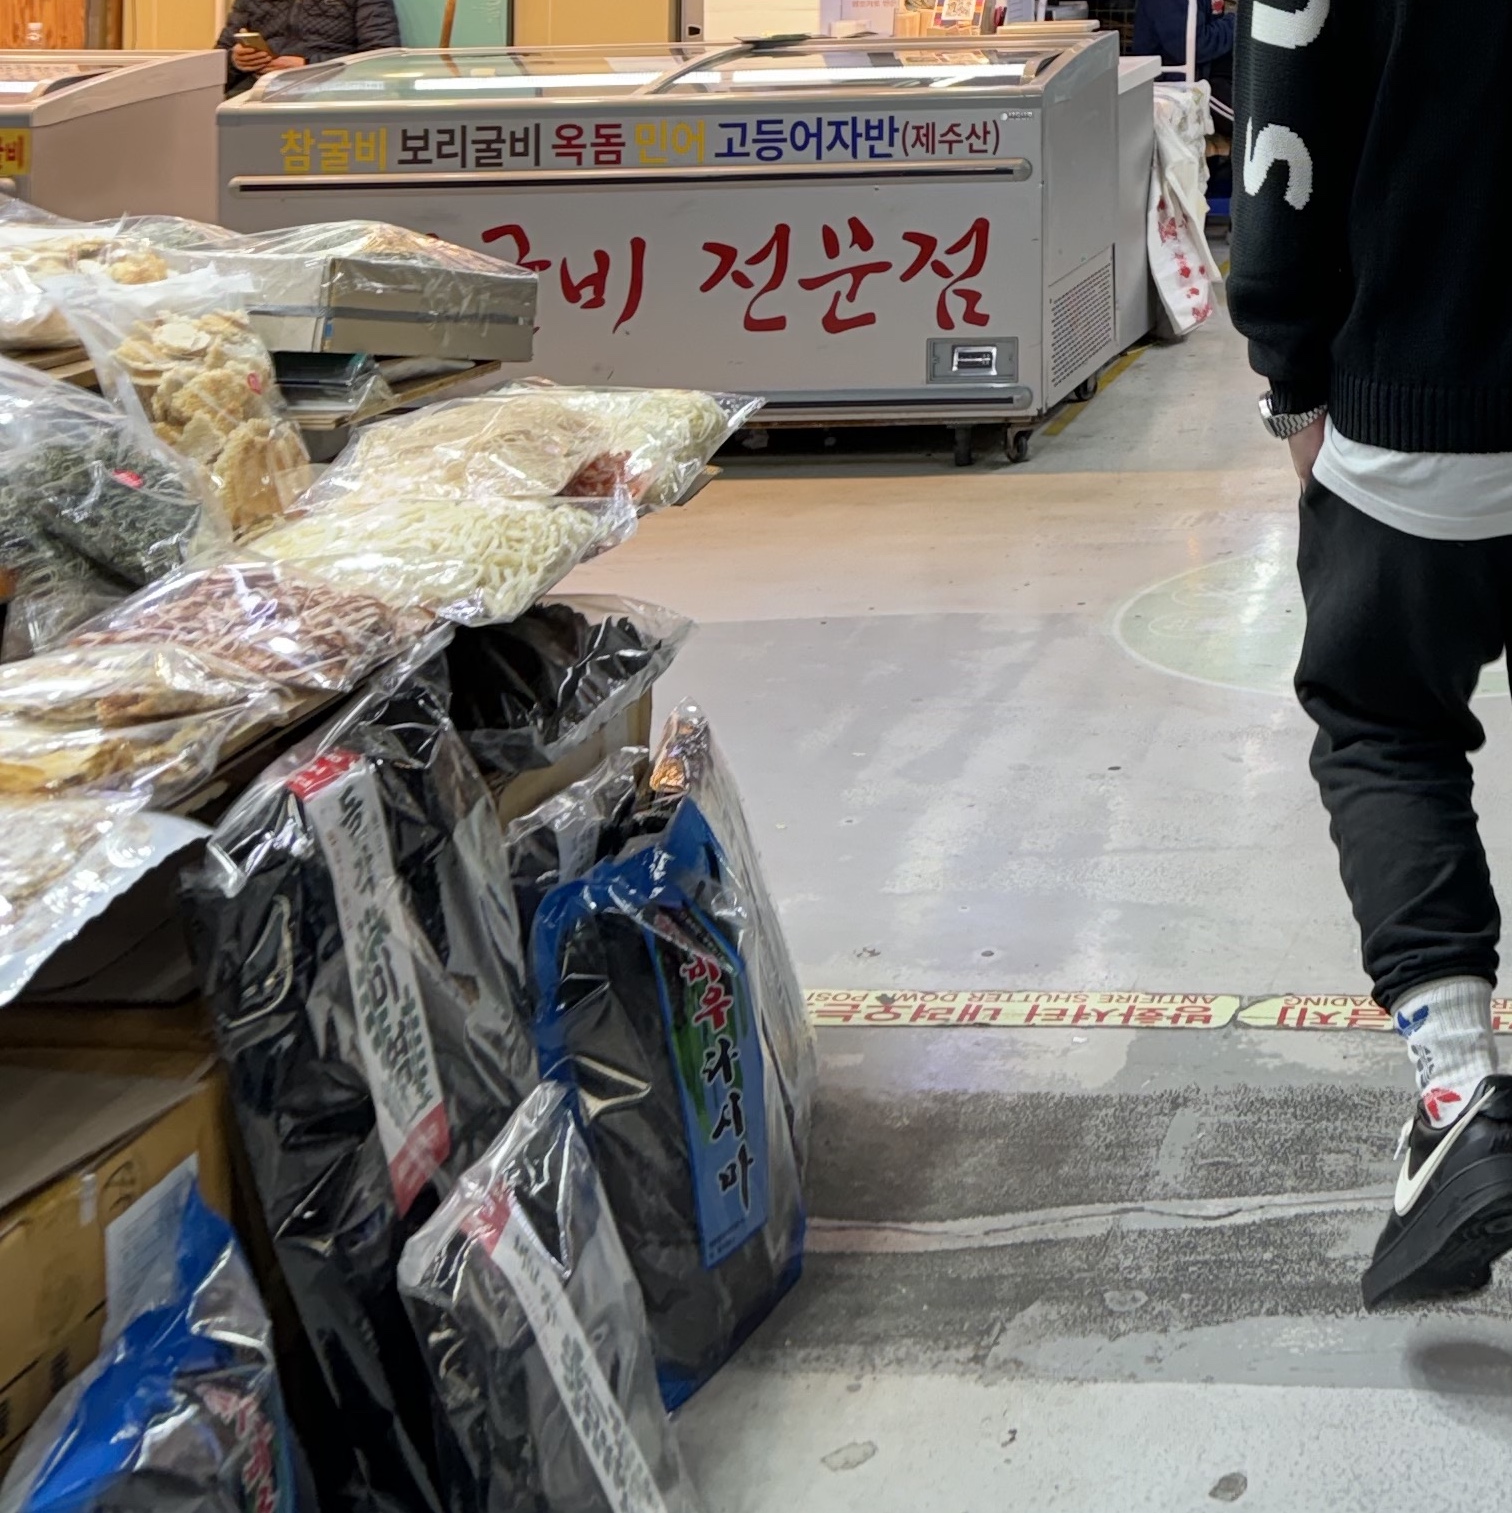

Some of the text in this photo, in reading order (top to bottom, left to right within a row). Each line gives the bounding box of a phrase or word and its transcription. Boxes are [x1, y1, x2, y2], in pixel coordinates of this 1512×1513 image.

[279, 130, 389, 174] 참굴비
[397, 123, 543, 170] 보리굴비
[549, 120, 627, 168] 옥돔
[634, 118, 707, 164] 민어
[700, 217, 995, 333] 전문점
[967, 991, 1089, 1004] SHUTTER
[1024, 1004, 1213, 1027] 방화셔터
[1101, 993, 1217, 1006] ANTIFIRE
[701, 1034, 754, 1213] 다시마
